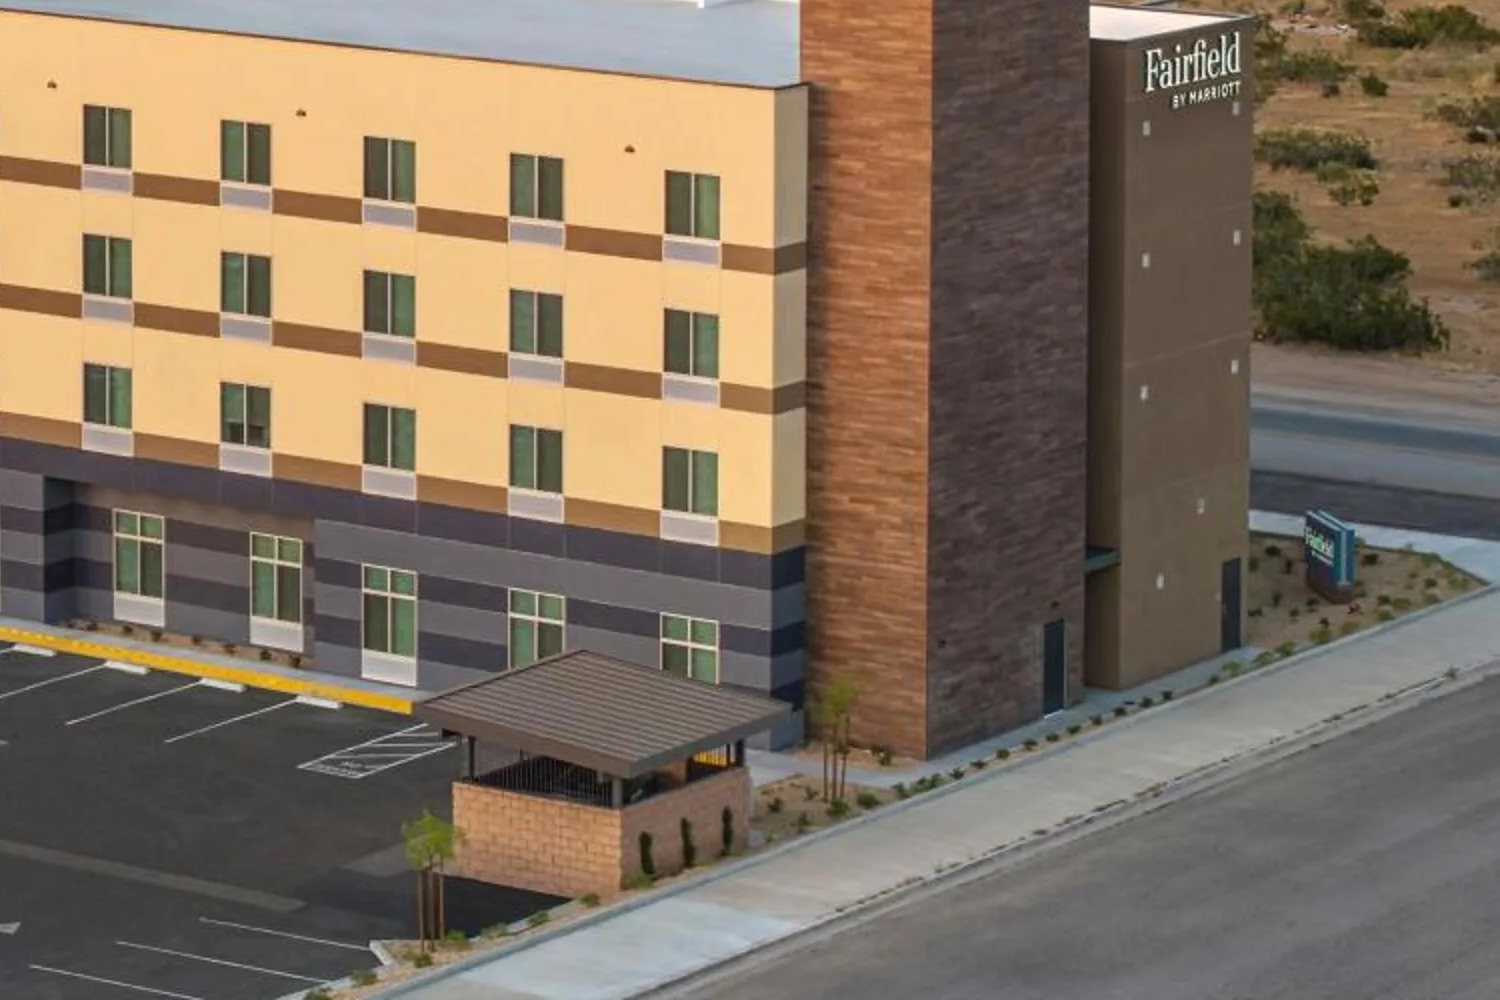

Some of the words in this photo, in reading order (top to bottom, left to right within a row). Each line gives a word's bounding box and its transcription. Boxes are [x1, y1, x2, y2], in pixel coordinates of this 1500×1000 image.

[1145, 31, 1241, 93] Fairfield
[1172, 93, 1187, 109] BY
[1189, 81, 1241, 105] MARRIOTT
